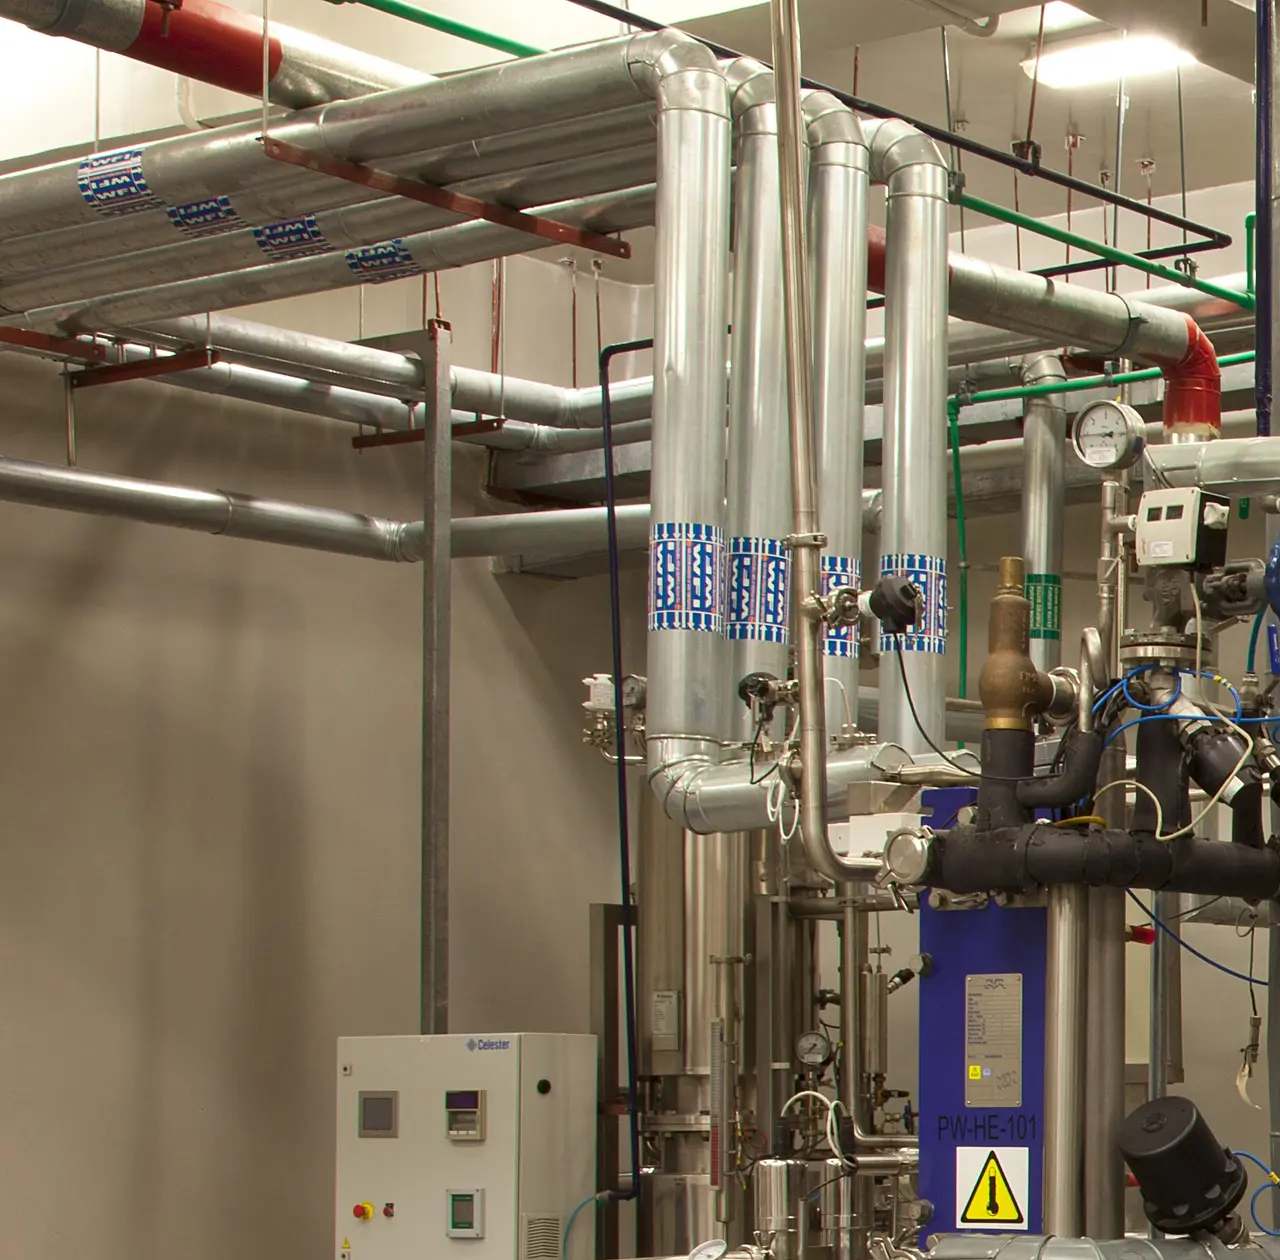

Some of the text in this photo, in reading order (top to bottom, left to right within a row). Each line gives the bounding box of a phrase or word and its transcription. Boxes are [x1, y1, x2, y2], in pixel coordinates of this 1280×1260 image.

[91, 153, 132, 167] WFI
[91, 175, 131, 190] WFI
[96, 186, 137, 201] WFI
[179, 200, 218, 216] WFI
[184, 211, 225, 226] WFI
[263, 221, 304, 236] WFI
[269, 232, 309, 246] WFI
[667, 541, 675, 607] WFI
[692, 543, 701, 608] WFI
[705, 543, 713, 608] WFI
[730, 558, 739, 621] WFI
[741, 557, 751, 620] WFI
[766, 560, 776, 623] WFI
[777, 561, 786, 623] WFI
[477, 1039, 511, 1050] Celester
[937, 1114, 1037, 1142] PW-HE-101
